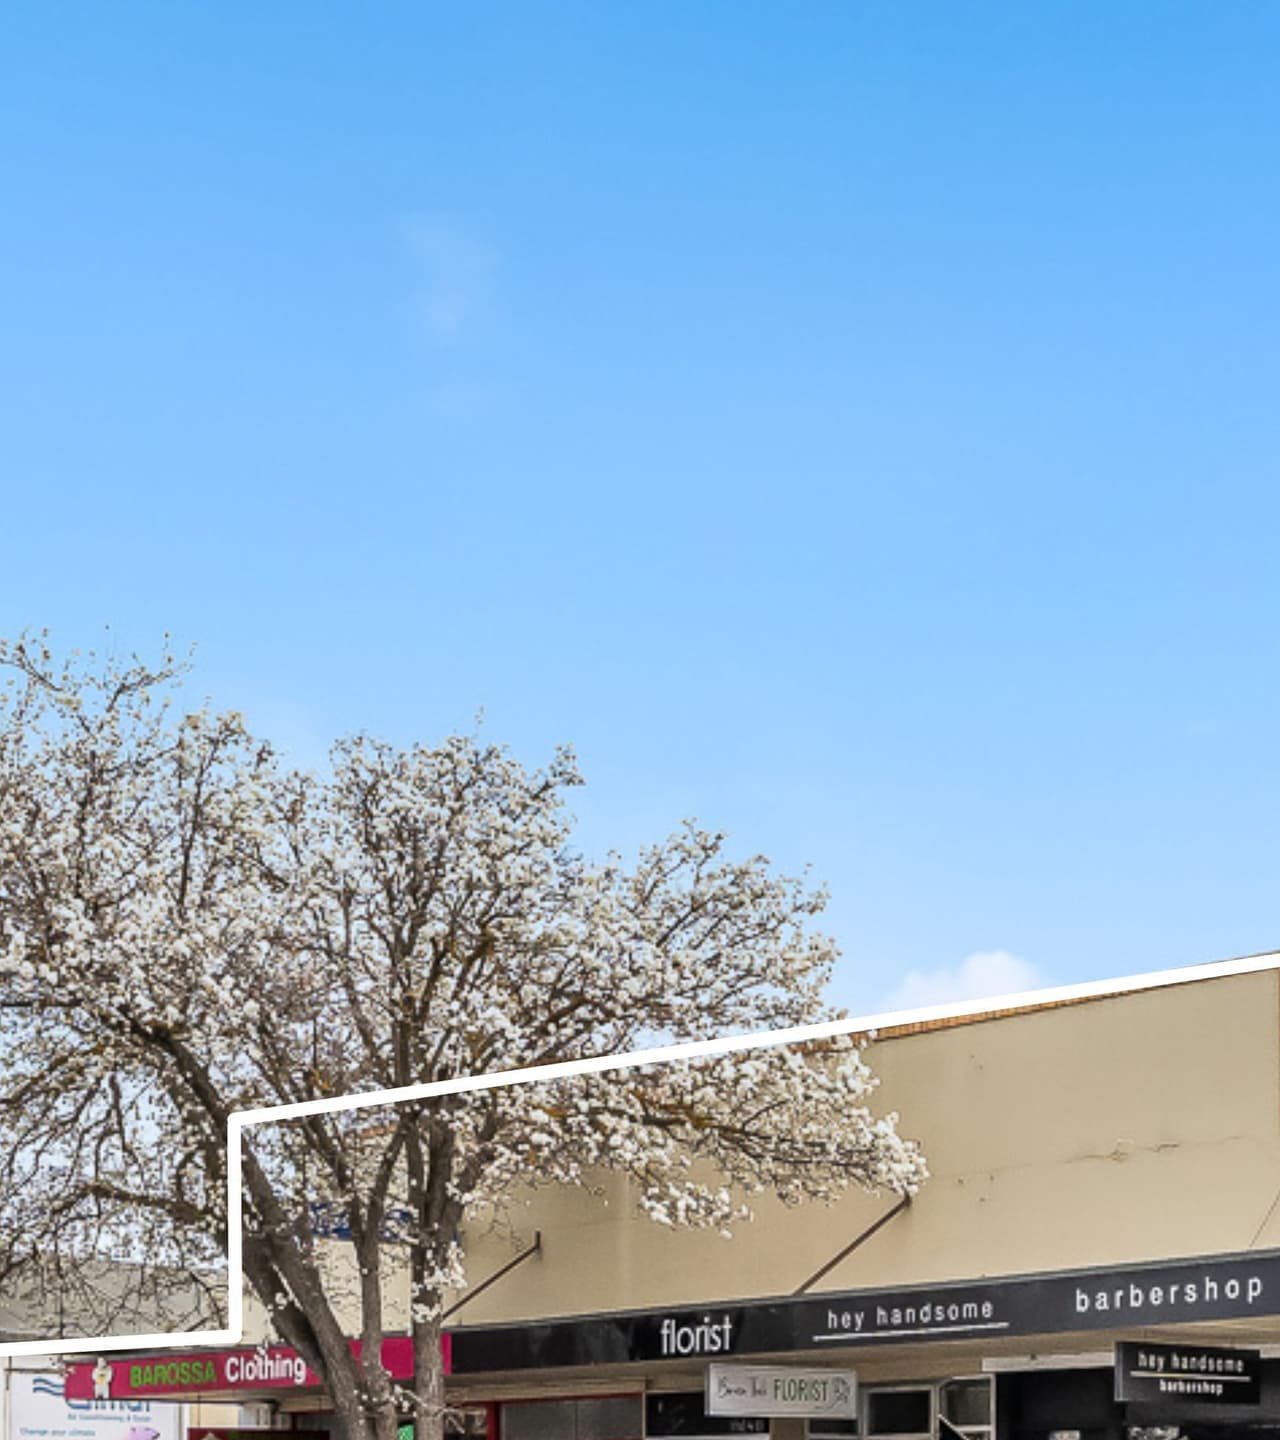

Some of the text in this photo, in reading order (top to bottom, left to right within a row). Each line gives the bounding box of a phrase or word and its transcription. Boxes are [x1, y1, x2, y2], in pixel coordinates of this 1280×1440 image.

[1075, 1276, 1263, 1312] barbershop
[827, 1300, 994, 1332] hey handsome
[661, 1315, 733, 1355] florist
[130, 1354, 307, 1388] BAROSSA Clothing
[1137, 1351, 1245, 1373] hey handsome
[773, 1377, 828, 1402] FLORIST
[1159, 1379, 1224, 1396] barbershop
